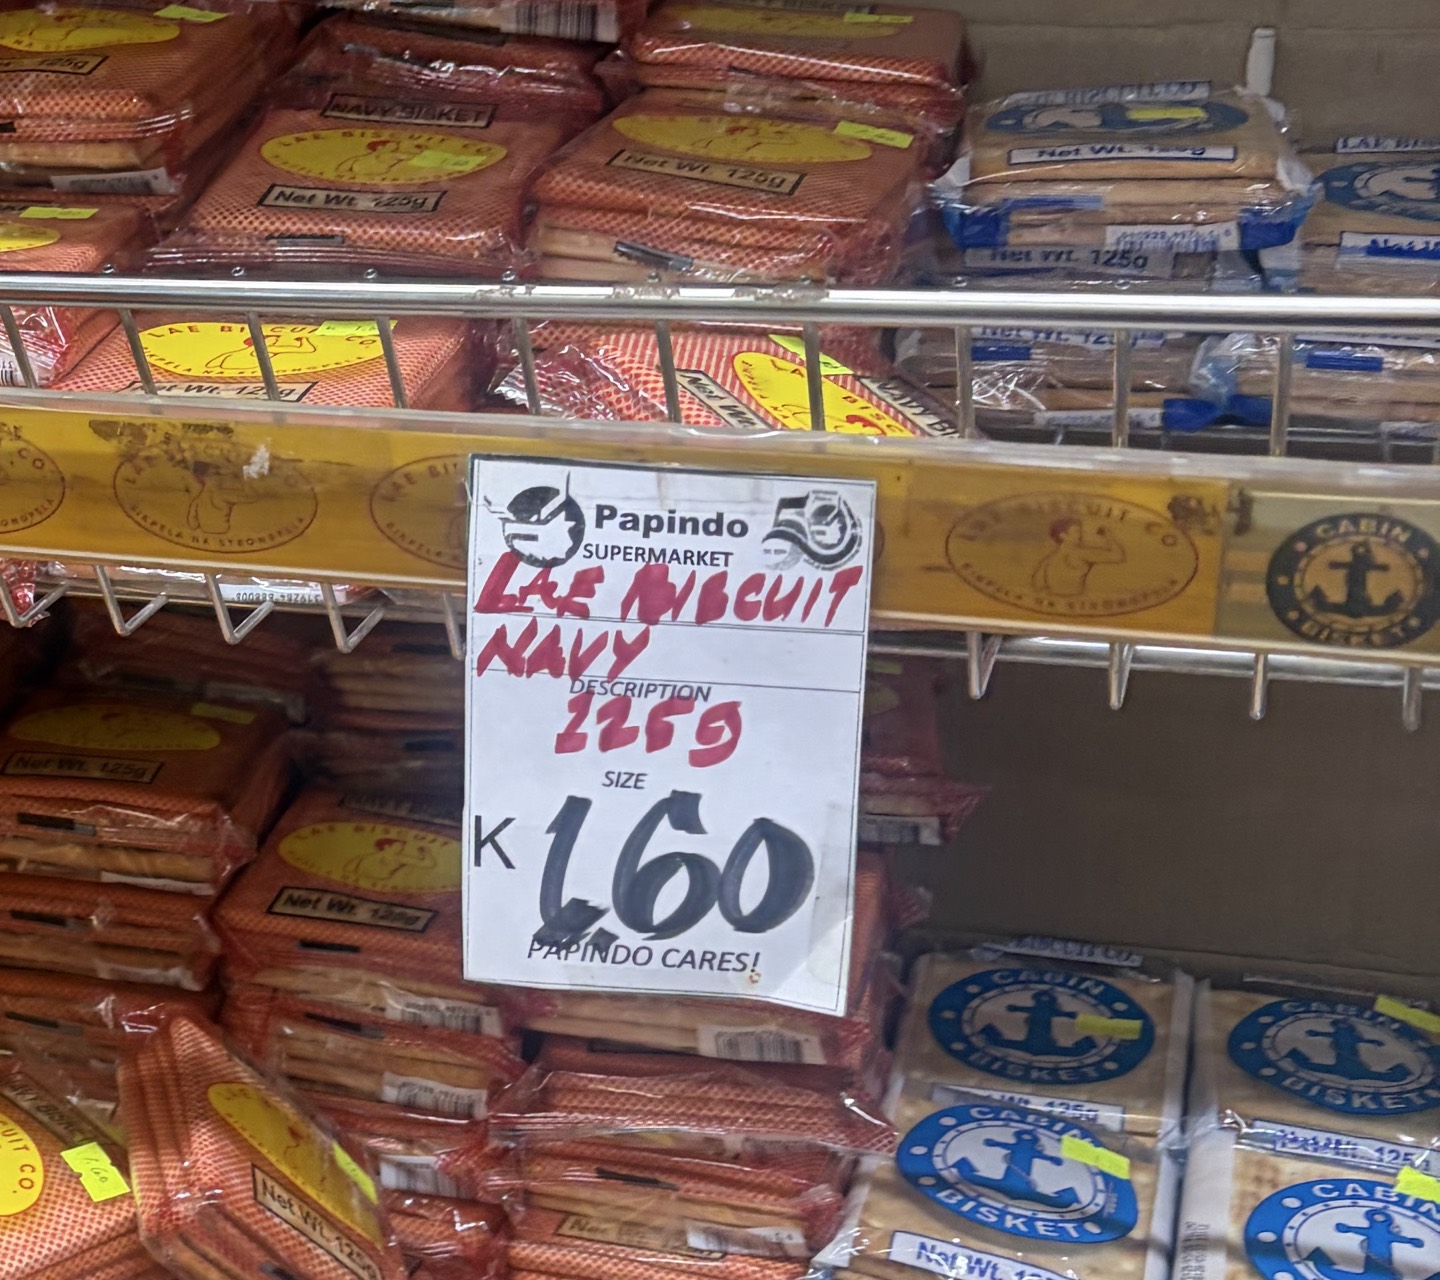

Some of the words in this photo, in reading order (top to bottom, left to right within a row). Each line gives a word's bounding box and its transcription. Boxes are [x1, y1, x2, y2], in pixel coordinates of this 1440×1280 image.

[332, 102, 391, 122] NAVY
[623, 152, 668, 173] Net
[726, 166, 788, 191] 125g
[273, 188, 324, 207] Net
[1091, 249, 1149, 268] 125g
[147, 322, 201, 340] LAE
[680, 372, 721, 404] Net
[592, 504, 750, 540] Papindo
[1314, 519, 1412, 543] CABIN
[582, 542, 735, 568] SUPERMARKET
[472, 550, 606, 620] LAE
[476, 617, 652, 683] NAVY
[568, 677, 713, 704] DESCRIPTION
[601, 770, 648, 791] SIZE
[473, 815, 516, 870] K
[527, 938, 654, 969] PAPINDO
[660, 947, 761, 975] CARES!
[990, 968, 1108, 996] CABIN
[967, 1051, 1102, 1083] BISKET
[1282, 1074, 1423, 1112] BISKET
[935, 1186, 1083, 1240] BISKET
[915, 1240, 963, 1269] Net
